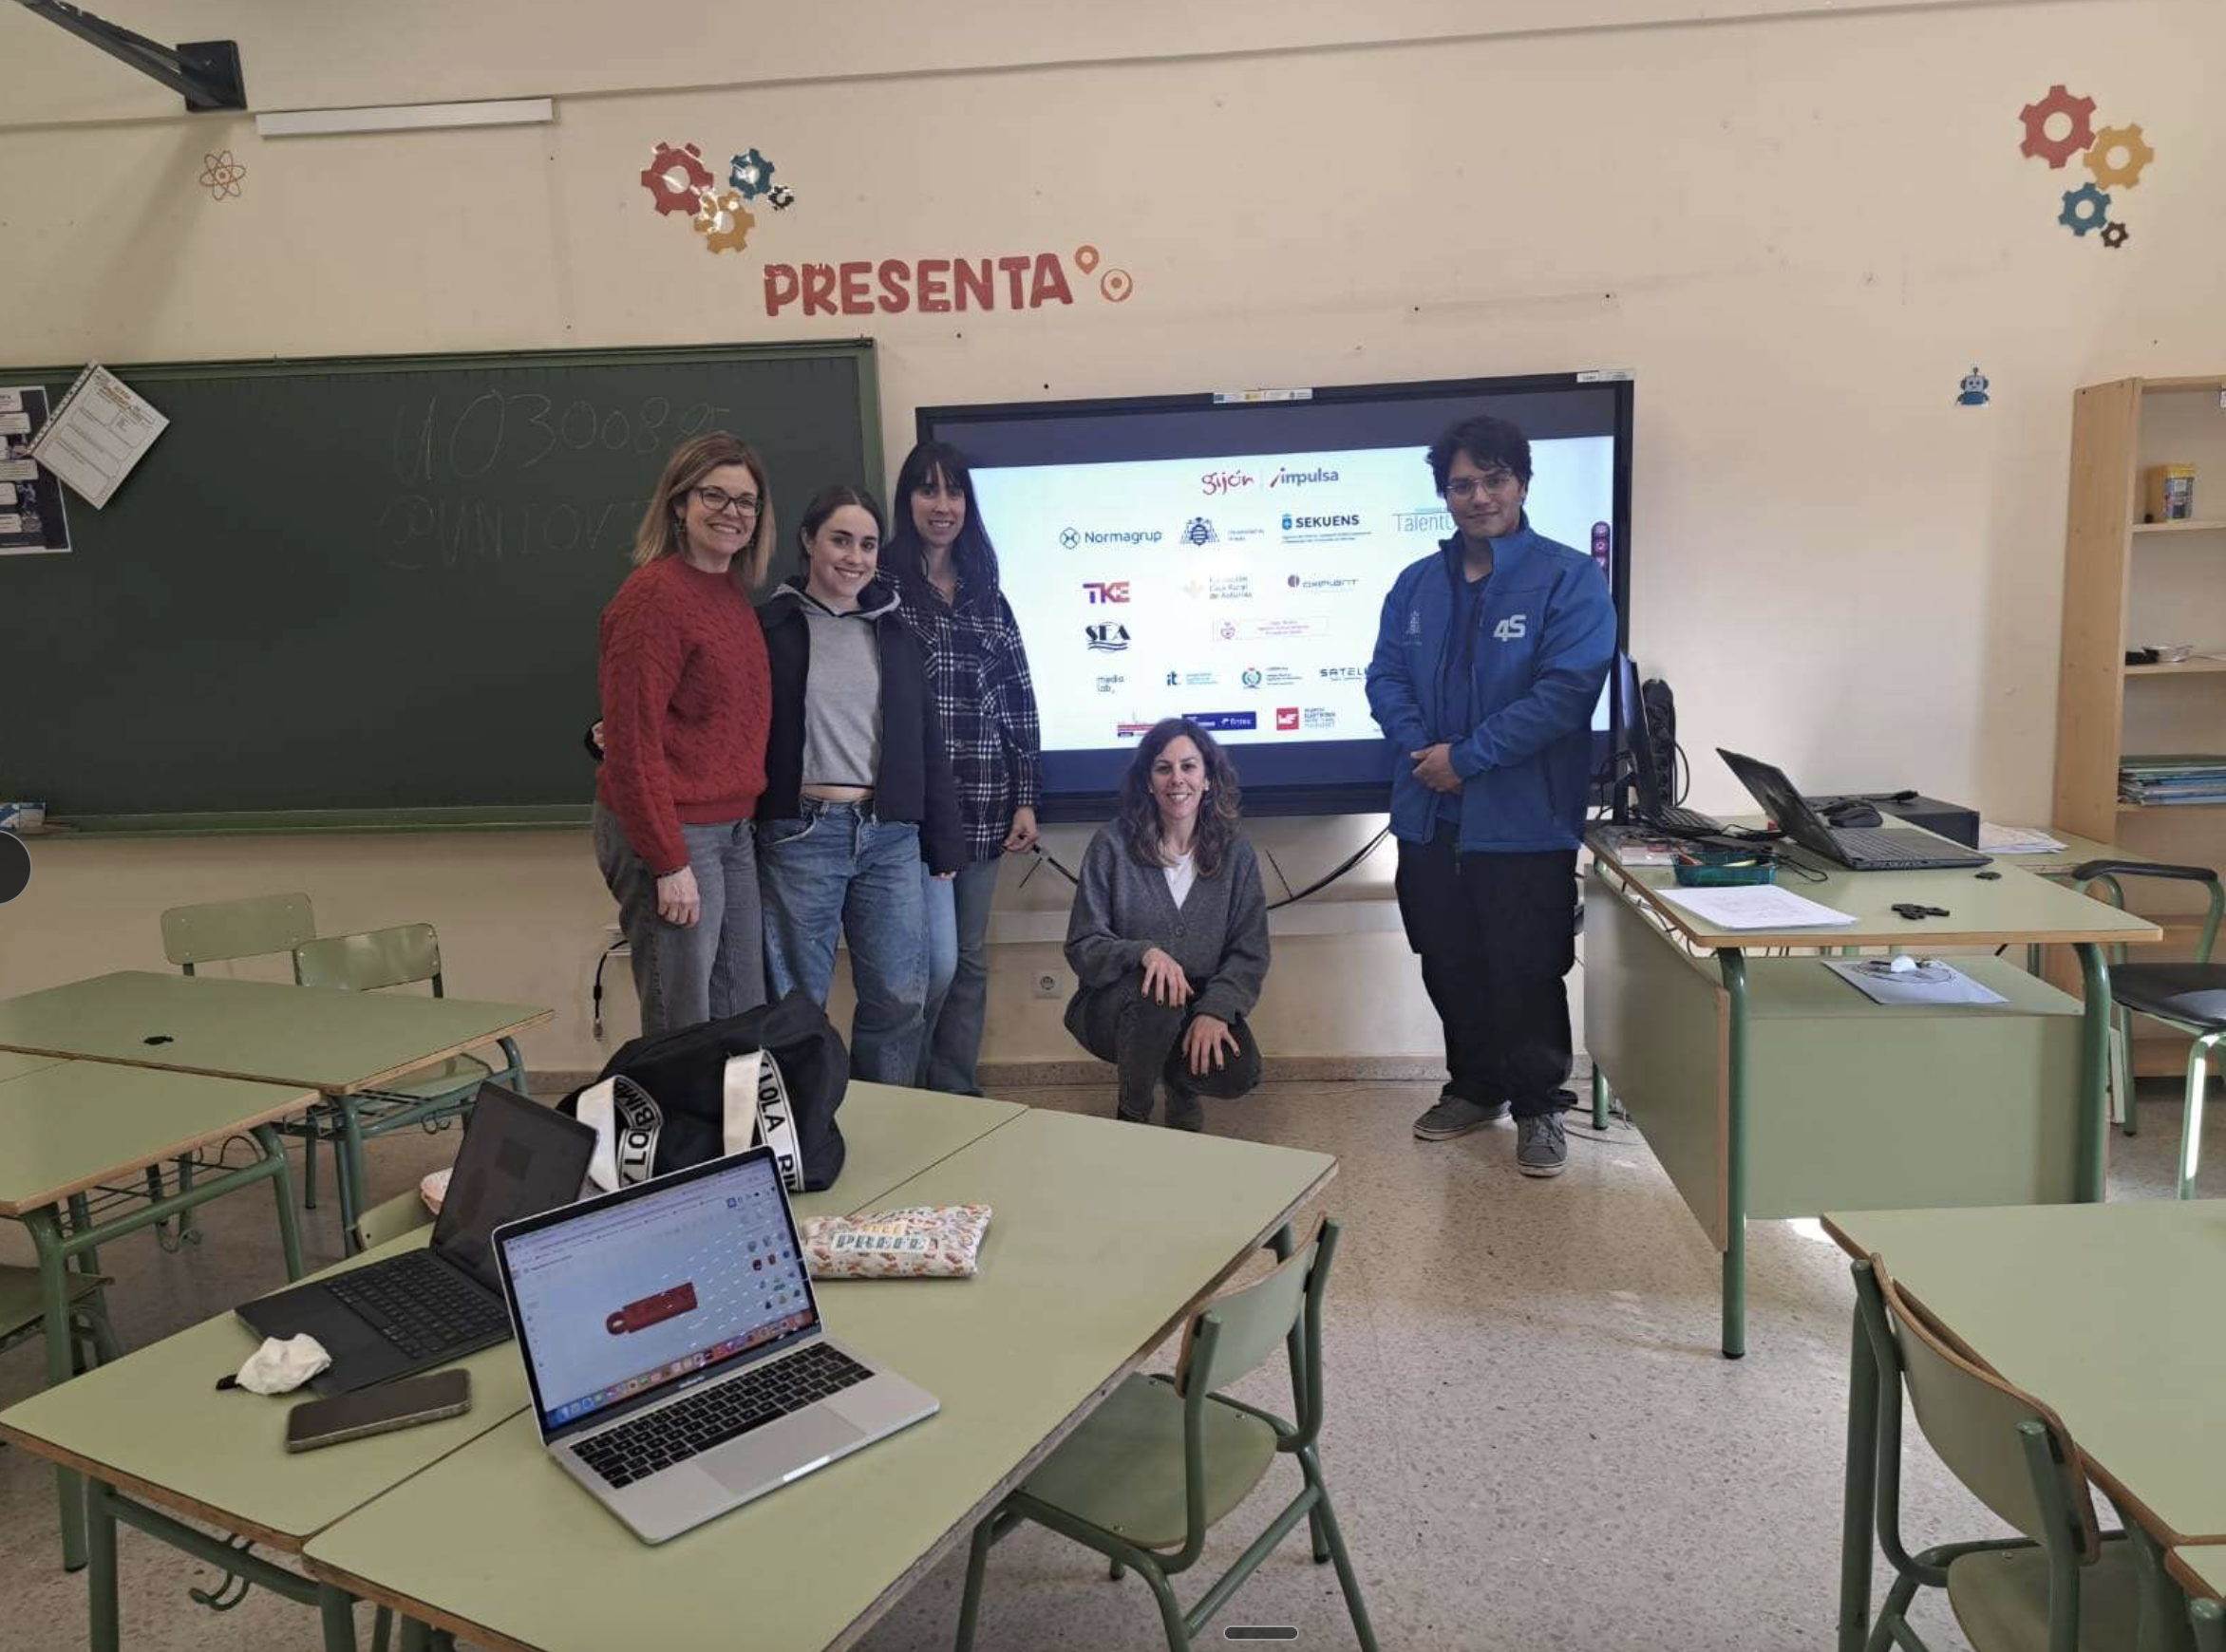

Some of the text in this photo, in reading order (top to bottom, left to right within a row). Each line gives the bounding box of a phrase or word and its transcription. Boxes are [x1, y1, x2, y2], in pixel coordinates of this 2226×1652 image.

[764, 253, 1074, 317] PRESENTA
[1270, 467, 1340, 488] impulsa
[1295, 515, 1360, 529] SEKUENS
[1085, 530, 1163, 545] Normagrup
[1083, 581, 1130, 604] TKE
[1493, 614, 1527, 642] 4S
[1166, 670, 1178, 685] it
